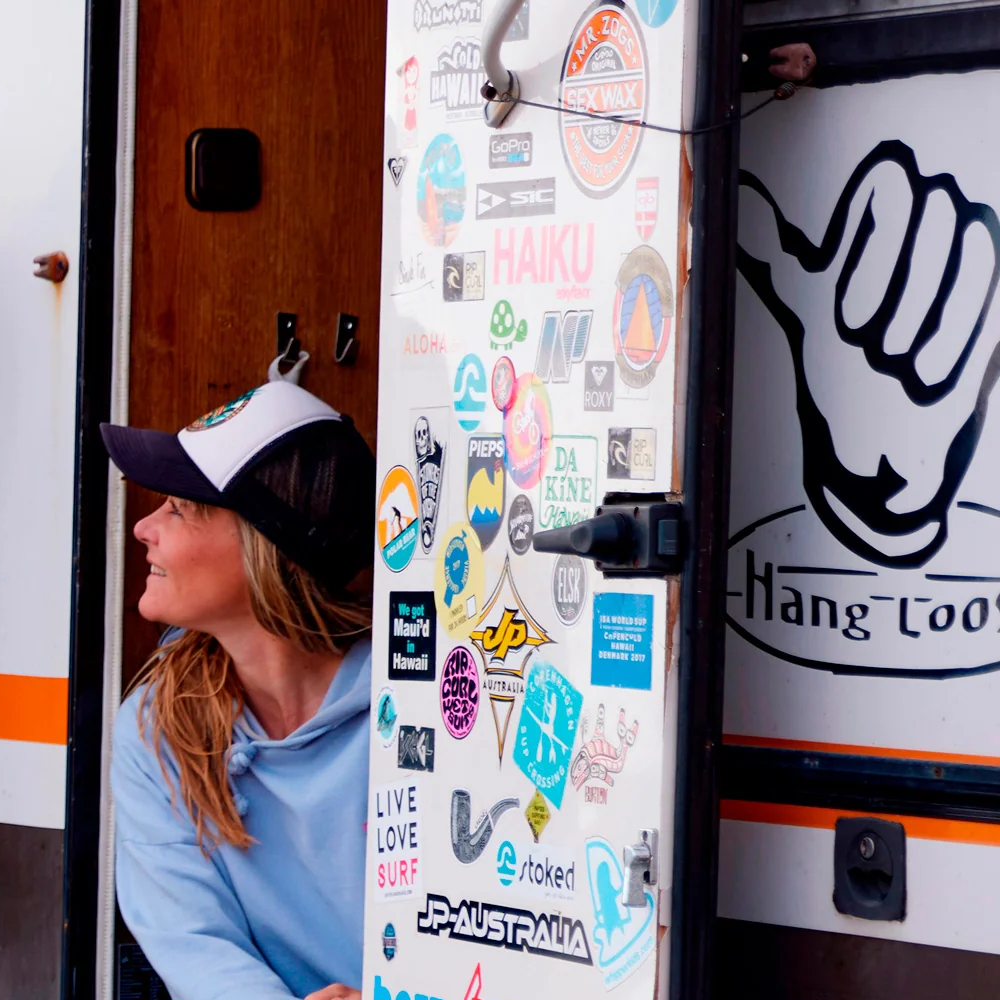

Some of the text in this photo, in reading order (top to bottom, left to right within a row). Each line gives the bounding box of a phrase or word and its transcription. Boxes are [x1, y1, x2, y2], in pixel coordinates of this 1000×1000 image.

[601, 16, 635, 56] ZOGS
[567, 80, 638, 113] SEX WAX
[491, 139, 530, 154] GoPro
[493, 222, 595, 285] HAIKU
[404, 333, 447, 354] ALOHA
[585, 391, 613, 407] ROXY
[469, 440, 504, 458] PIEPS
[555, 447, 577, 472] DA
[558, 567, 581, 603] ELSK
[745, 548, 1000, 641] Hang Loo
[398, 604, 425, 620] We got
[393, 619, 430, 638] Maui'd
[407, 641, 415, 654] in
[599, 651, 629, 661] DENMARK
[393, 653, 428, 671] Hawaii
[444, 650, 468, 678] RIP
[442, 676, 478, 705] CURL
[482, 680, 524, 694] AUSTRALIA
[527, 762, 566, 789] CROSSING
[376, 786, 417, 818] LIVE
[377, 822, 417, 853] LOVE
[377, 858, 418, 889] SURF
[519, 854, 575, 891] stoked
[418, 897, 590, 960] JP-AUSTRALIA
